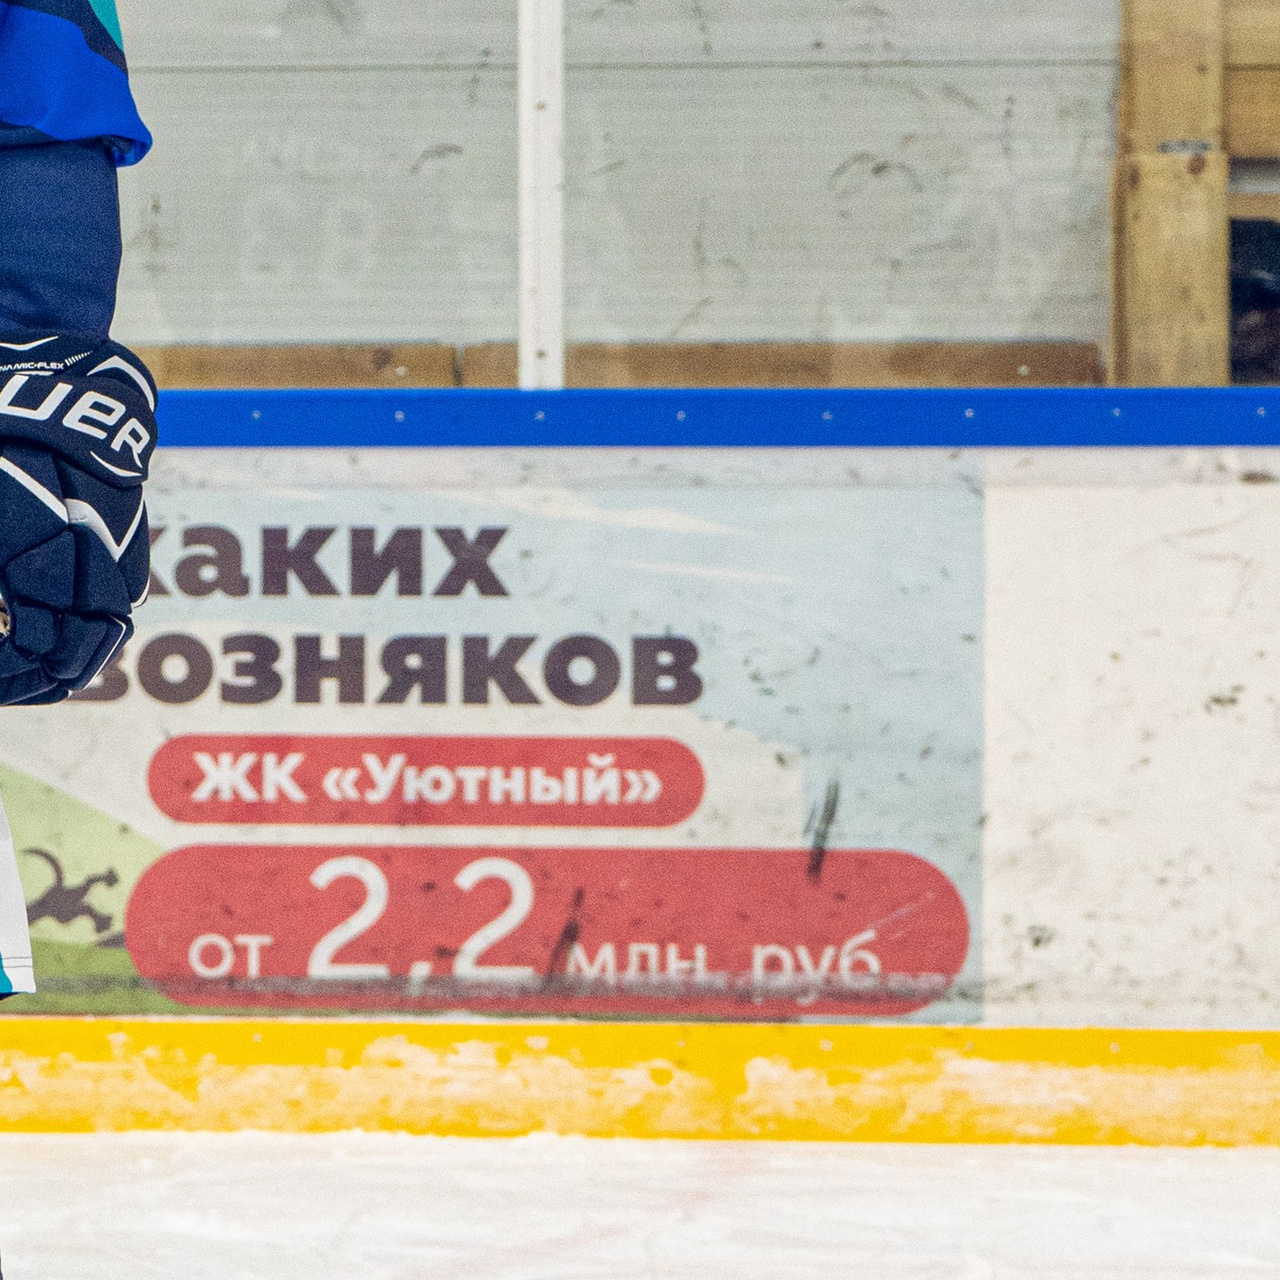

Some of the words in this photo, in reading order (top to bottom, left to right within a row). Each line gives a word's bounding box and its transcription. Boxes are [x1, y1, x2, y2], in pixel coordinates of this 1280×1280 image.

[191, 751, 308, 803] ЖК
[322, 752, 663, 806] «Уютный»
[188, 933, 273, 980] от
[307, 855, 536, 997] 2,2
